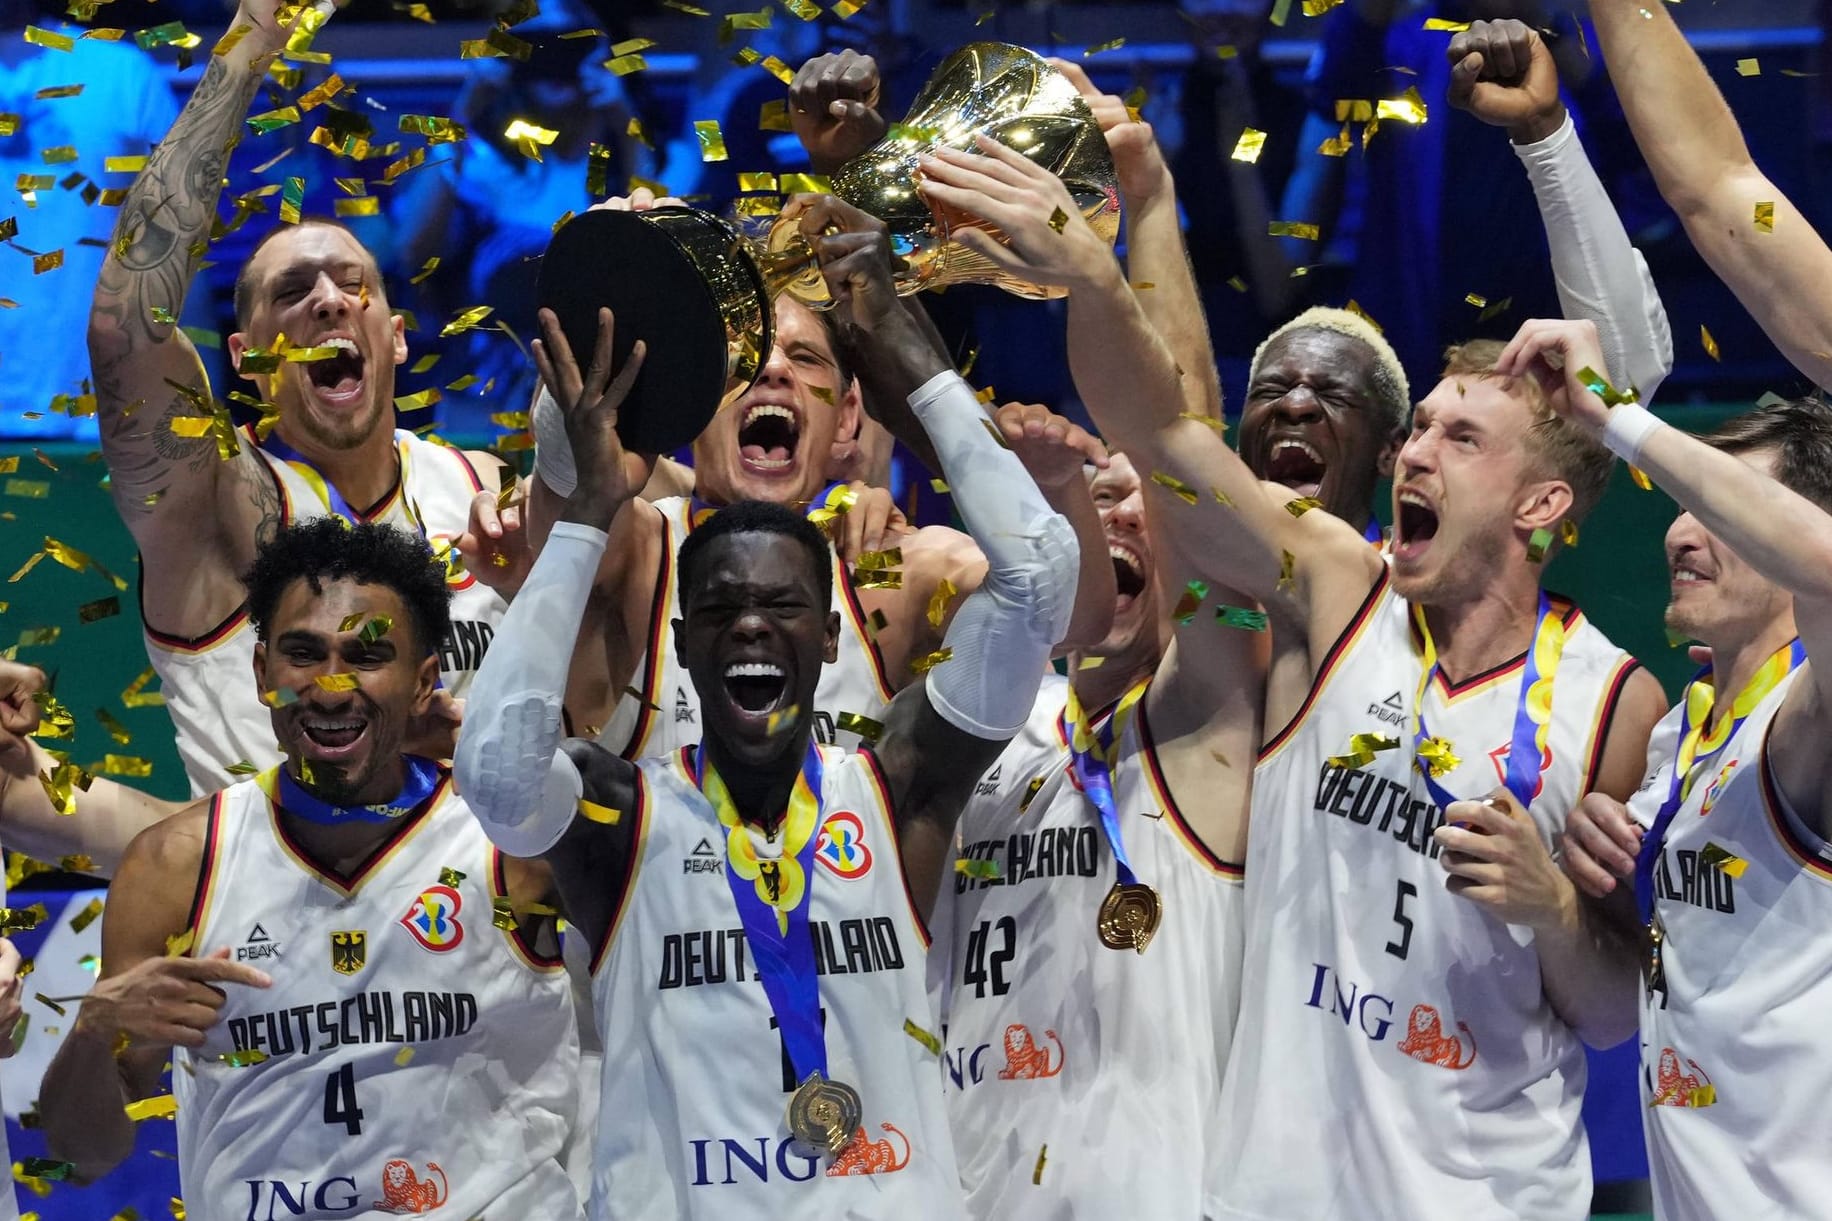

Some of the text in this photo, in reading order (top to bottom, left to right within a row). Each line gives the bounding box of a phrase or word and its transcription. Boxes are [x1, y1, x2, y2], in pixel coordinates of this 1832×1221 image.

[1367, 703, 1409, 729] PEAK
[684, 859, 724, 875] PEAK
[1385, 878, 1417, 960] 5
[237, 942, 282, 961] PEAK
[964, 916, 1016, 998] 42
[228, 991, 478, 1057] DEUTSCHLAND
[1304, 963, 1394, 1041] ING
[324, 1061, 364, 1136] 4
[689, 1136, 821, 1185] ING
[246, 1175, 362, 1221] ING
